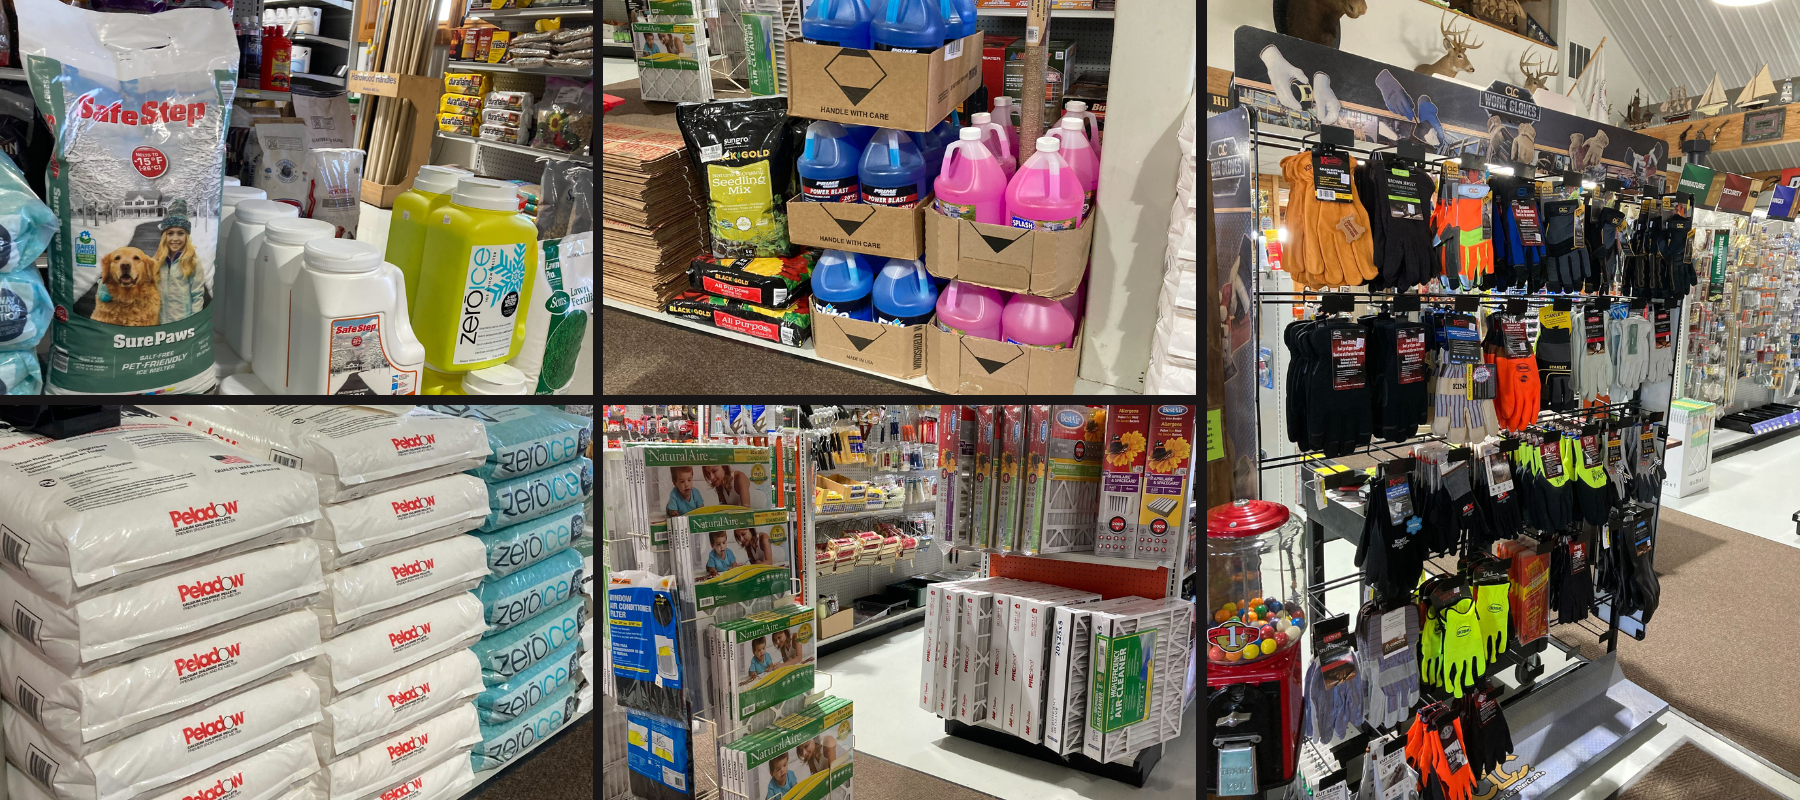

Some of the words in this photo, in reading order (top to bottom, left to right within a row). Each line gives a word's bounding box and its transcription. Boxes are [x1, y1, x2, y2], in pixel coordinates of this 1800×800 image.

[748, 24, 756, 66] CLEANER
[351, 73, 375, 82] Hardwood
[376, 75, 396, 85] Handles
[449, 75, 472, 87] duraflame
[1484, 93, 1508, 109] WORK
[1509, 99, 1538, 118] GLOVES
[820, 106, 849, 116] HANDLE
[851, 109, 868, 118] WITH
[870, 112, 889, 120] CARE
[441, 115, 463, 126] duraflame
[741, 149, 770, 158] GOLD
[742, 169, 765, 177] Organic
[1222, 158, 1241, 176] GLOVES
[712, 174, 766, 188] Seedling
[1680, 179, 1706, 190] MINIATURE
[728, 186, 751, 195] Mix
[1723, 188, 1742, 197] SECURITY
[1012, 219, 1033, 229] SPLASH
[819, 235, 845, 245] HANDLE
[846, 238, 862, 247] WITH
[863, 241, 881, 249] CARE
[1716, 236, 1724, 274] MINIATURE
[545, 262, 559, 270] Lawn
[715, 274, 732, 282] BLACK
[734, 277, 749, 285] GOLD
[570, 285, 589, 297] Lawn
[724, 283, 749, 294] Purpose
[669, 305, 691, 314] BLACK
[693, 308, 711, 317] GOLD
[722, 316, 733, 324] All
[735, 318, 772, 333] Purpose
[140, 351, 174, 360] SALT-FREE
[912, 333, 923, 370] WINDSHIELD
[122, 353, 188, 371] PET-FRIENDLY
[149, 364, 175, 374] MELTER
[1061, 413, 1080, 424] BestAir
[391, 434, 435, 450] Peladow
[649, 448, 709, 462] NaturalAire
[215, 466, 239, 474] QUALITY
[391, 495, 435, 514] Peladow
[169, 500, 238, 528] Peladow
[693, 518, 738, 530] NaturalAire
[391, 558, 434, 580] Peladow
[177, 573, 244, 602] Peladow
[619, 603, 651, 612] CONDITIONER
[388, 622, 430, 647] Peladow
[739, 623, 778, 641] NaturalAire
[174, 642, 240, 676] Peladow
[1112, 650, 1120, 683] EFFICIENCY
[1118, 648, 1127, 699] CLEANER
[388, 682, 430, 707] Peladow
[182, 711, 245, 745] Peladow
[387, 733, 428, 760] Peladow
[751, 732, 802, 764] NaturalAire
[1389, 749, 1403, 758] SERIES
[1221, 767, 1252, 777] THANK
[1227, 782, 1246, 791] YOU
[1327, 785, 1343, 794] SERIES
